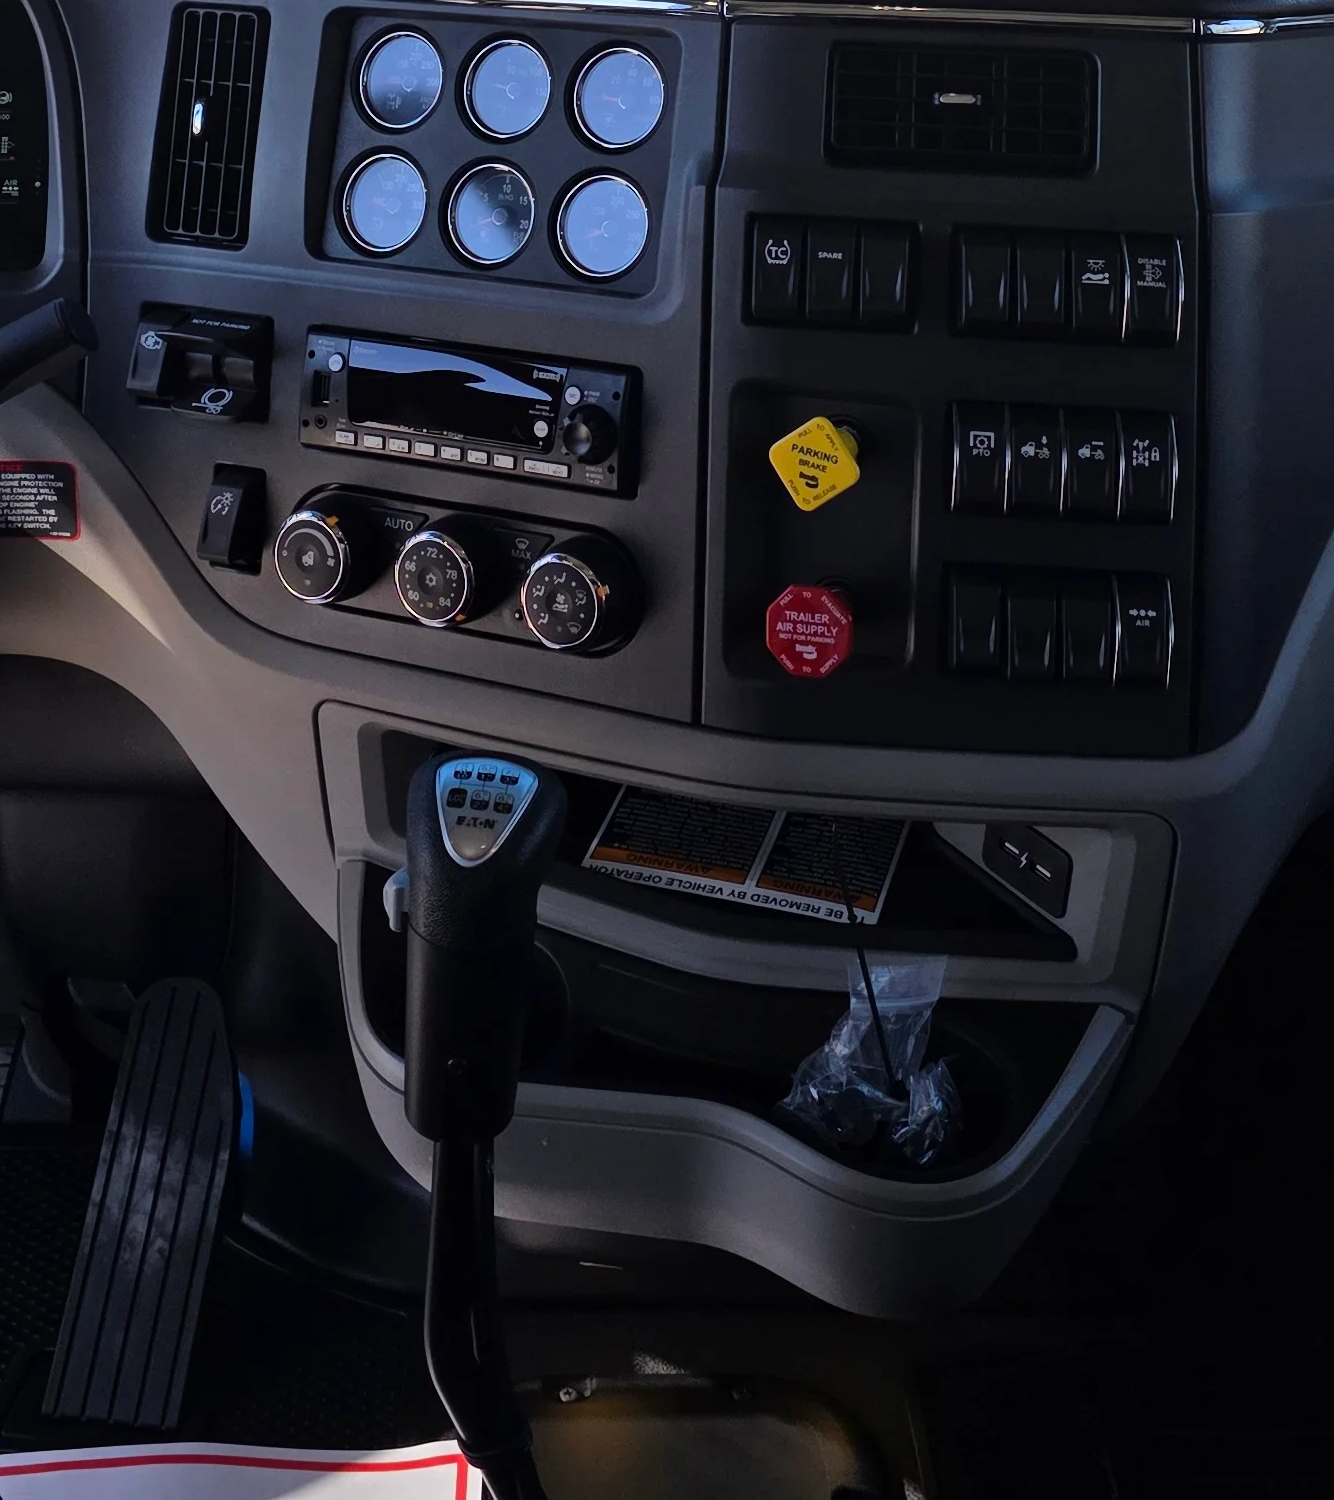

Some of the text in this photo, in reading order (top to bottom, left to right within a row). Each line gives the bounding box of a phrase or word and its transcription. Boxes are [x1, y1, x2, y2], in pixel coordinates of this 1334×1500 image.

[502, 184, 512, 192] 10
[519, 196, 528, 205] 15
[519, 219, 529, 229] 20
[769, 245, 787, 260] TC
[817, 251, 843, 260] SPARE
[1137, 257, 1167, 267] DISABLE
[1137, 280, 1167, 288] MANUAL
[816, 423, 825, 432] TO
[825, 433, 839, 452] APPLY
[791, 443, 839, 465] PARKING
[972, 447, 991, 457] PTO
[798, 458, 828, 473] BRAKE
[787, 478, 838, 505] PUSH TO RELEASE
[384, 516, 414, 532] AUTO
[426, 547, 438, 559] 72
[511, 549, 533, 561] MAX
[404, 560, 416, 572] 66
[446, 569, 458, 581] 78
[407, 590, 420, 601] 60
[438, 596, 452, 608] 84
[779, 591, 848, 625] PULL TO EVACUATE
[784, 610, 830, 624] TRAILER
[1135, 618, 1151, 627] AIR
[776, 621, 838, 637] AIR SUPPLY
[779, 632, 792, 640] NOT
[807, 635, 835, 644] PARKING
[779, 653, 795, 671] PUSH
[819, 654, 839, 674] SUPPLY
[624, 853, 700, 873] WARNING
[588, 863, 845, 920] BE REMOVED BY VEHICLE OPERATOR
[771, 878, 845, 902] WARNING
